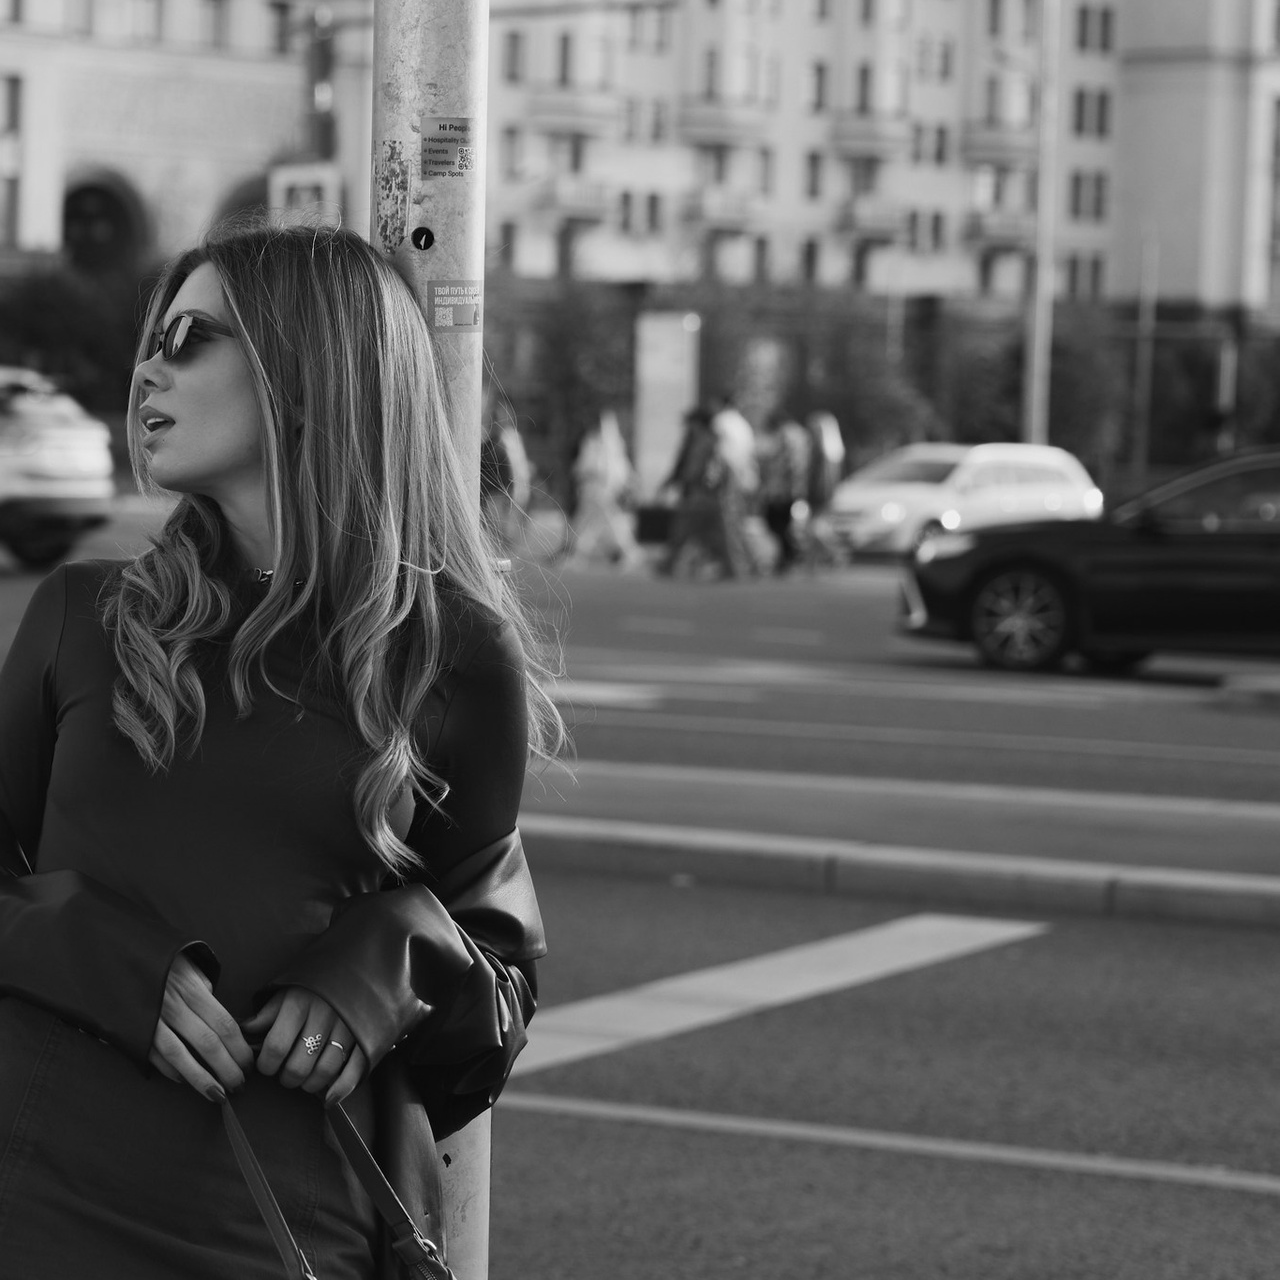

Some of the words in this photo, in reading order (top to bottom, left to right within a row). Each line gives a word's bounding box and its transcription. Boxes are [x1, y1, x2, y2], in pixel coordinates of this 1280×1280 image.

[428, 170, 447, 178] Camp
[448, 170, 464, 178] Spots
[434, 285, 450, 295] ТВОЙ
[450, 286, 464, 295] ПУТЬ
